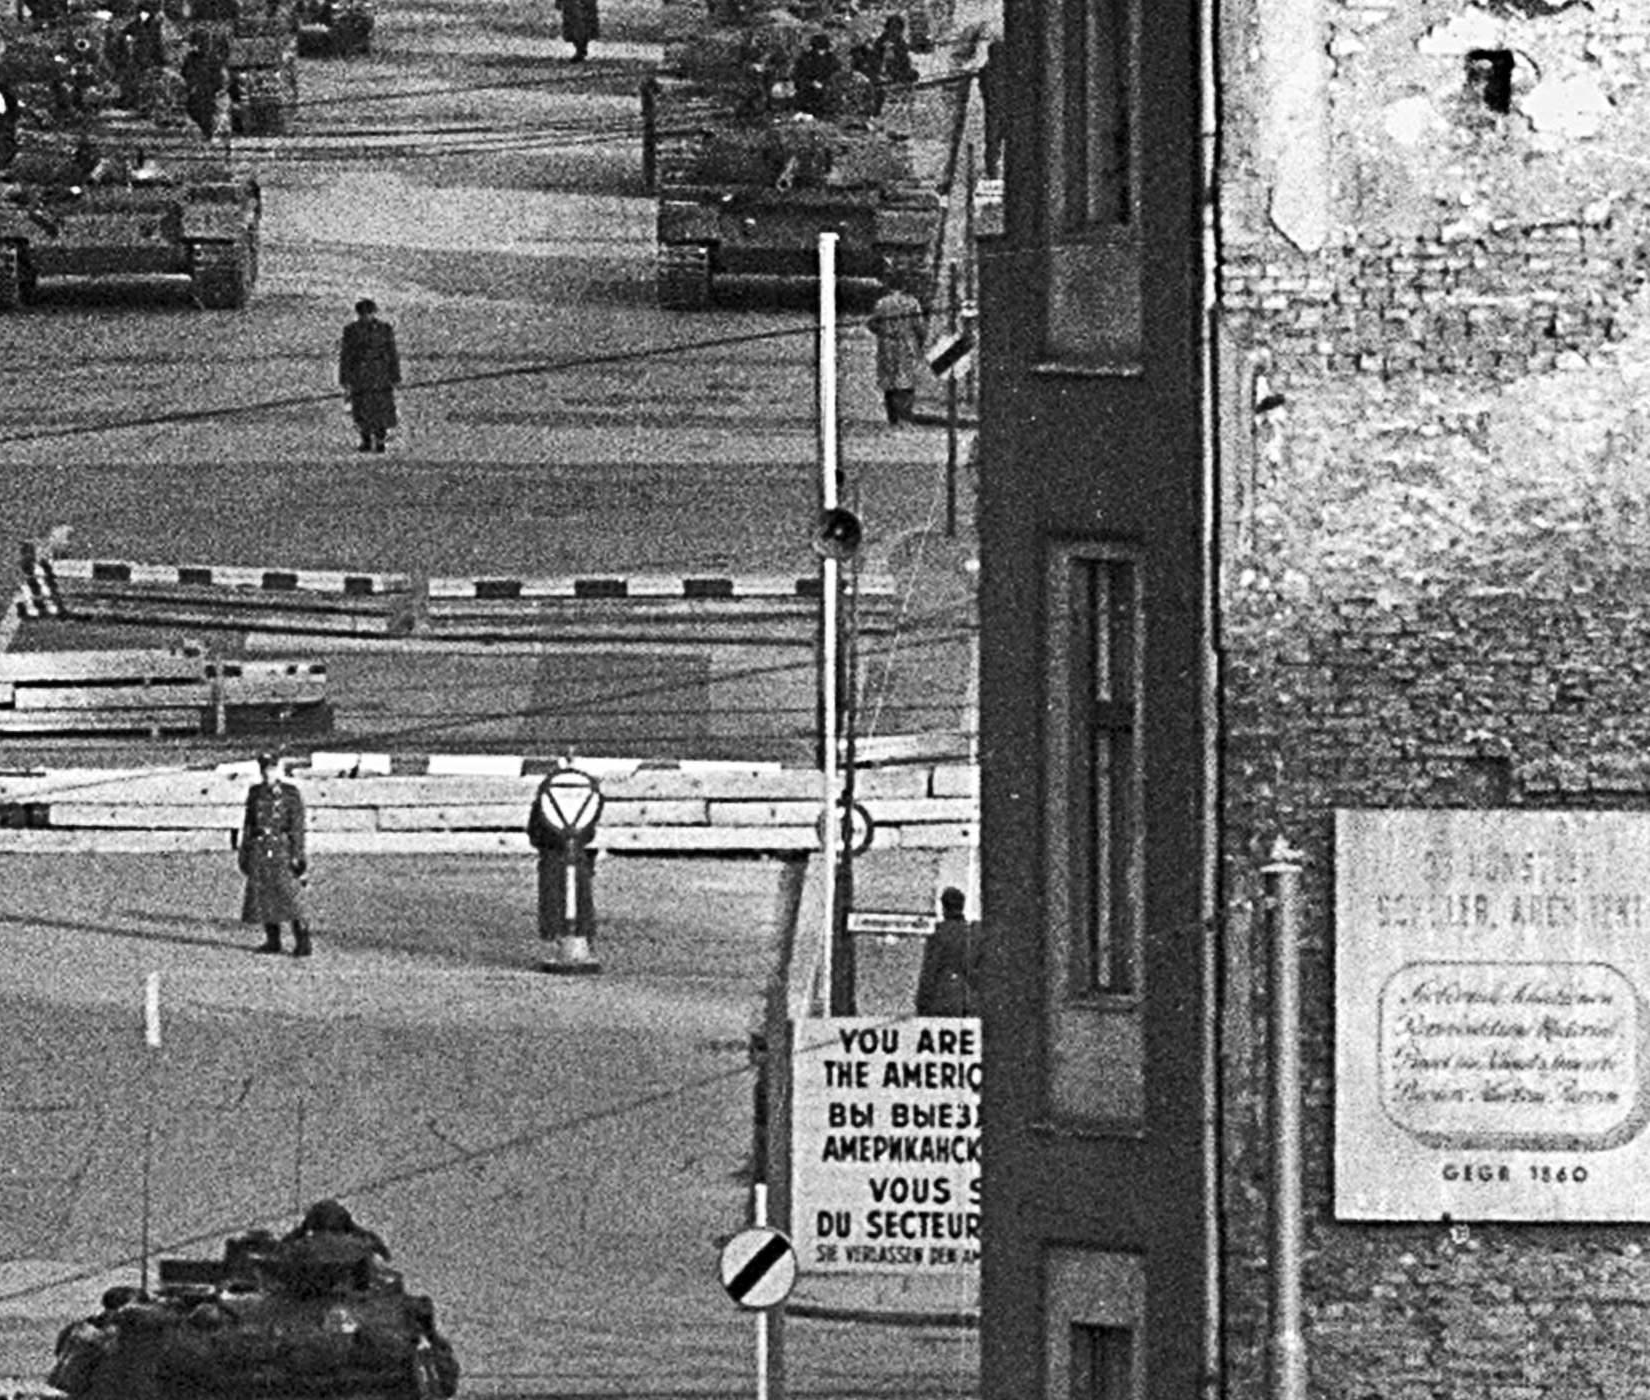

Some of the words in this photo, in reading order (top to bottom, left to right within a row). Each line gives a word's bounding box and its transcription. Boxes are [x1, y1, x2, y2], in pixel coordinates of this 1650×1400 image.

[839, 1028, 899, 1055] YOU
[916, 1028, 975, 1055] ARE
[823, 1060, 870, 1089] THE
[829, 1102, 874, 1129] ВЫ
[891, 1102, 982, 1129] ВЫЕЗ
[1530, 1165, 1588, 1183] 1860
[869, 1176, 951, 1205] VOUS
[816, 1210, 851, 1238] DU
[866, 1210, 982, 1240] SECTEUR
